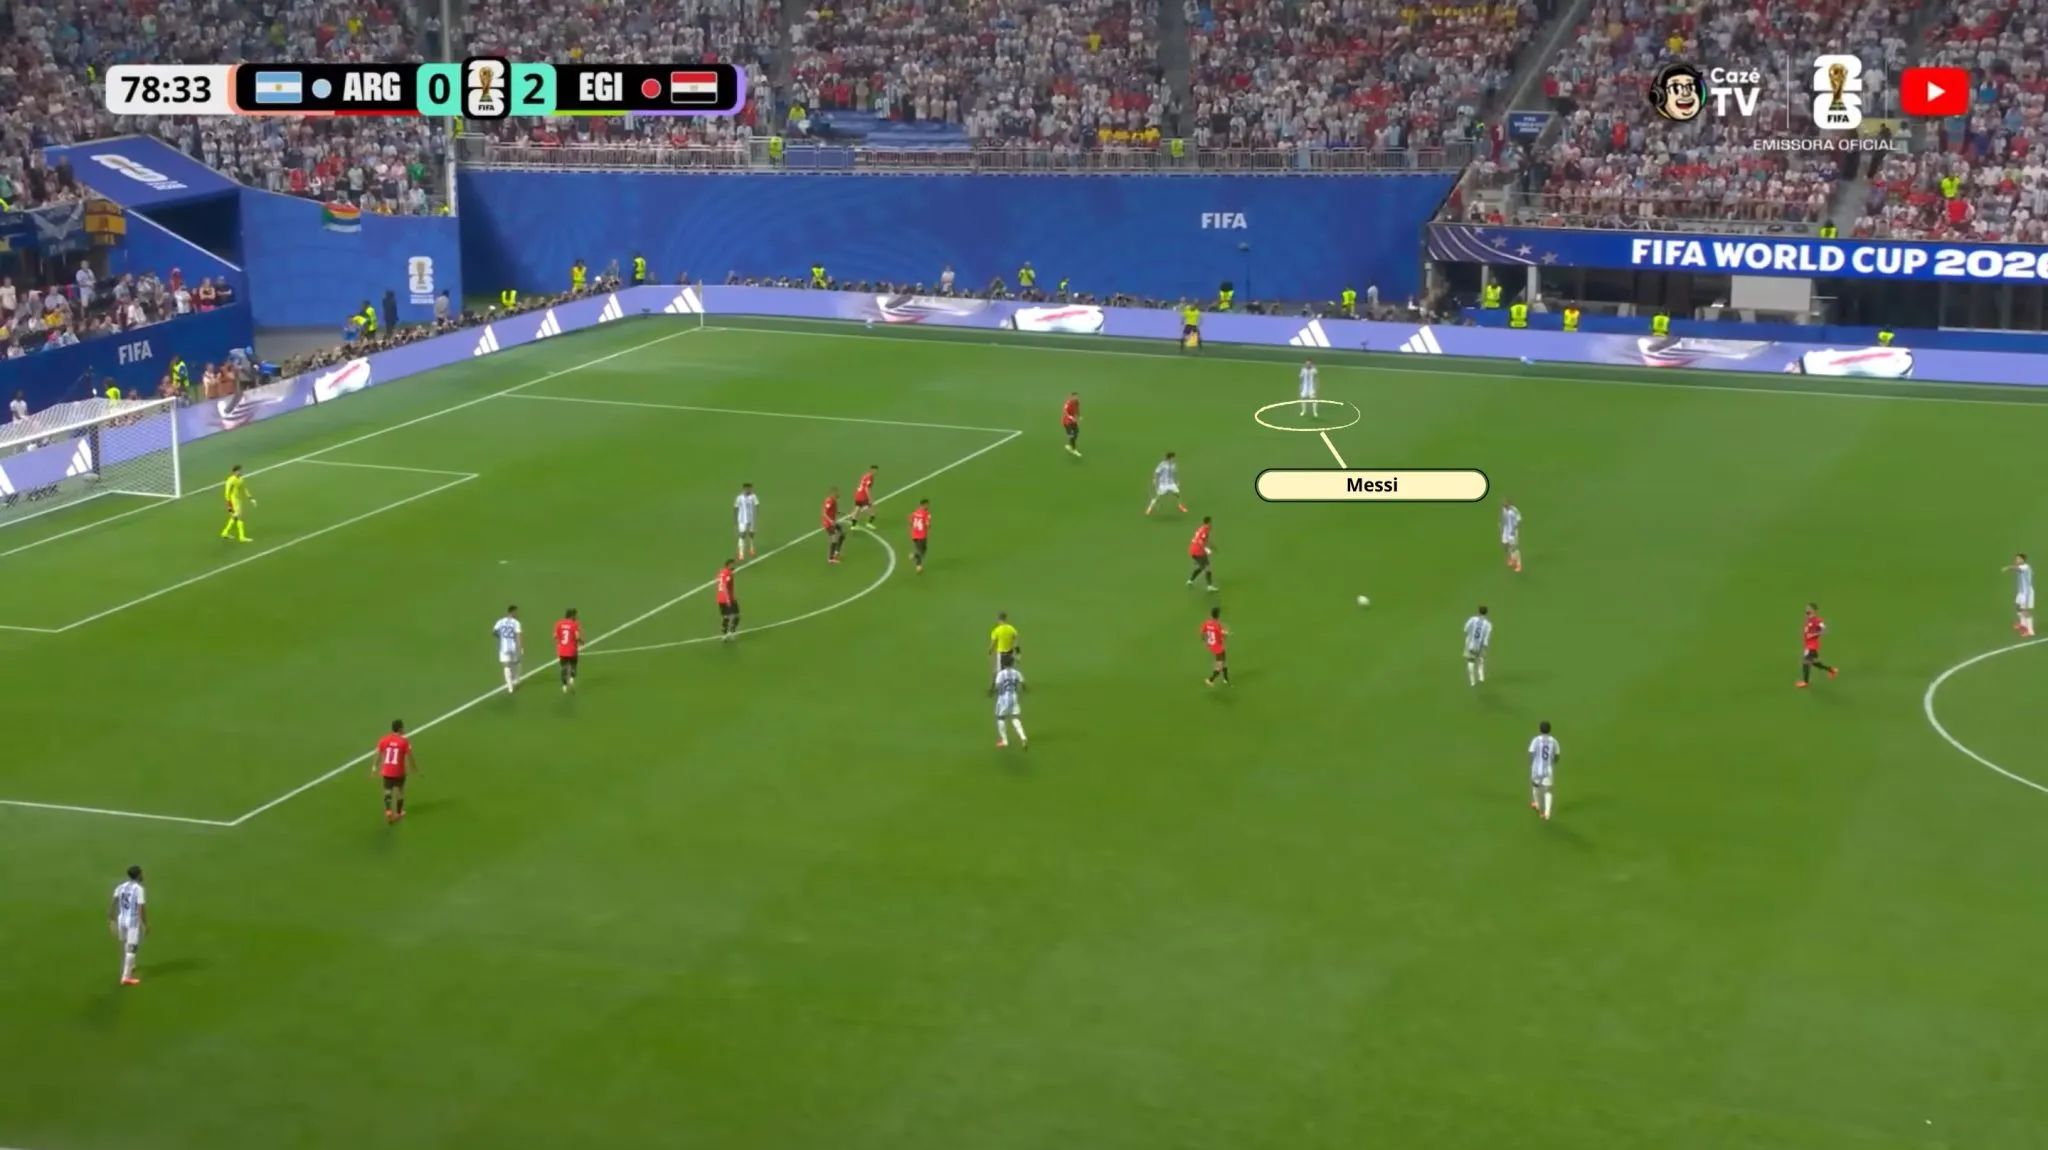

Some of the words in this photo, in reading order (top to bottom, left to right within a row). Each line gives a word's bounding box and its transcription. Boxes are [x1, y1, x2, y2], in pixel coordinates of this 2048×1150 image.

[1202, 212, 1248, 229] FIFA
[1631, 238, 1707, 267] FIFA
[1712, 242, 1845, 272] WORLD
[1852, 246, 1929, 275] CUP
[118, 340, 153, 365] FIFA
[561, 629, 569, 645] 3
[384, 747, 399, 765] 11
[1541, 745, 1550, 760] 6
